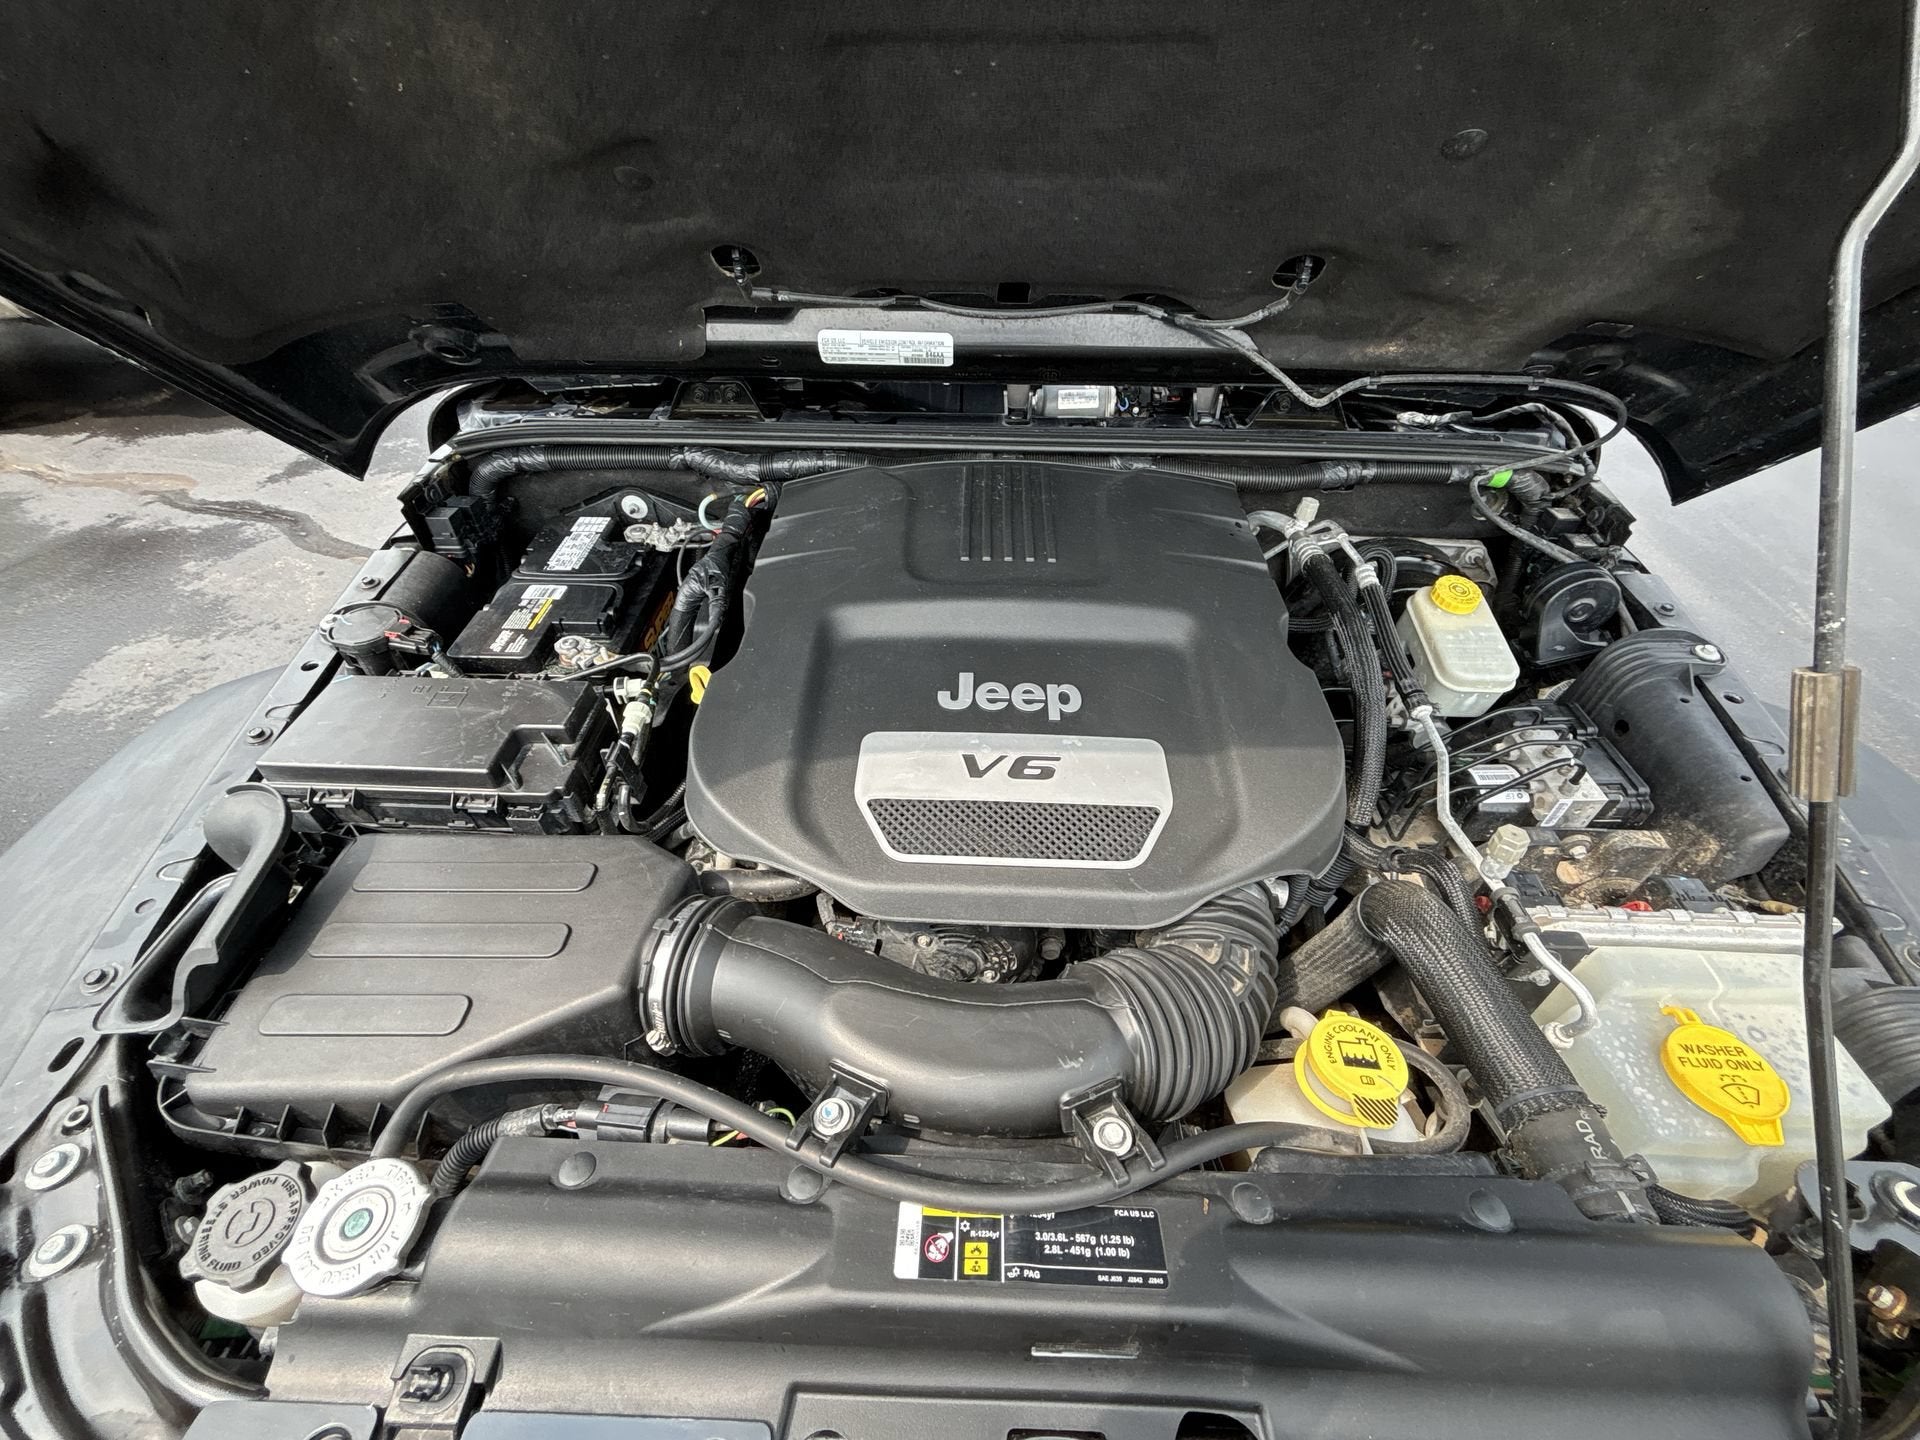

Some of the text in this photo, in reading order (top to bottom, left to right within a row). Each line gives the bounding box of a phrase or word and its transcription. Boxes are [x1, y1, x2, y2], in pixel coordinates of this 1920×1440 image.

[937, 672, 1082, 720] Jeep
[962, 754, 1062, 780] V6
[1324, 1024, 1396, 1071] ENGINE COOLANT ONLY
[1678, 1043, 1748, 1057] WASHER
[1677, 1056, 1765, 1071] FLUID ONLY
[251, 1179, 300, 1261] USE APPROVED
[1114, 1209, 1155, 1218] FCA US LLC
[198, 1176, 279, 1272] POWER STEERING FLUID
[970, 1230, 1000, 1240] R-1234yf
[1035, 1231, 1068, 1242] 3.0/3.6L
[1100, 1234, 1121, 1245] (1.25
[1122, 1235, 1135, 1247] lb)
[1044, 1244, 1063, 1254] 2.8L
[1069, 1245, 1091, 1258] 451g
[1095, 1246, 1116, 1258] (1.00
[1117, 1247, 1130, 1259] lb)
[1023, 1269, 1041, 1279] PAG
[1097, 1274, 1109, 1282] SAE
